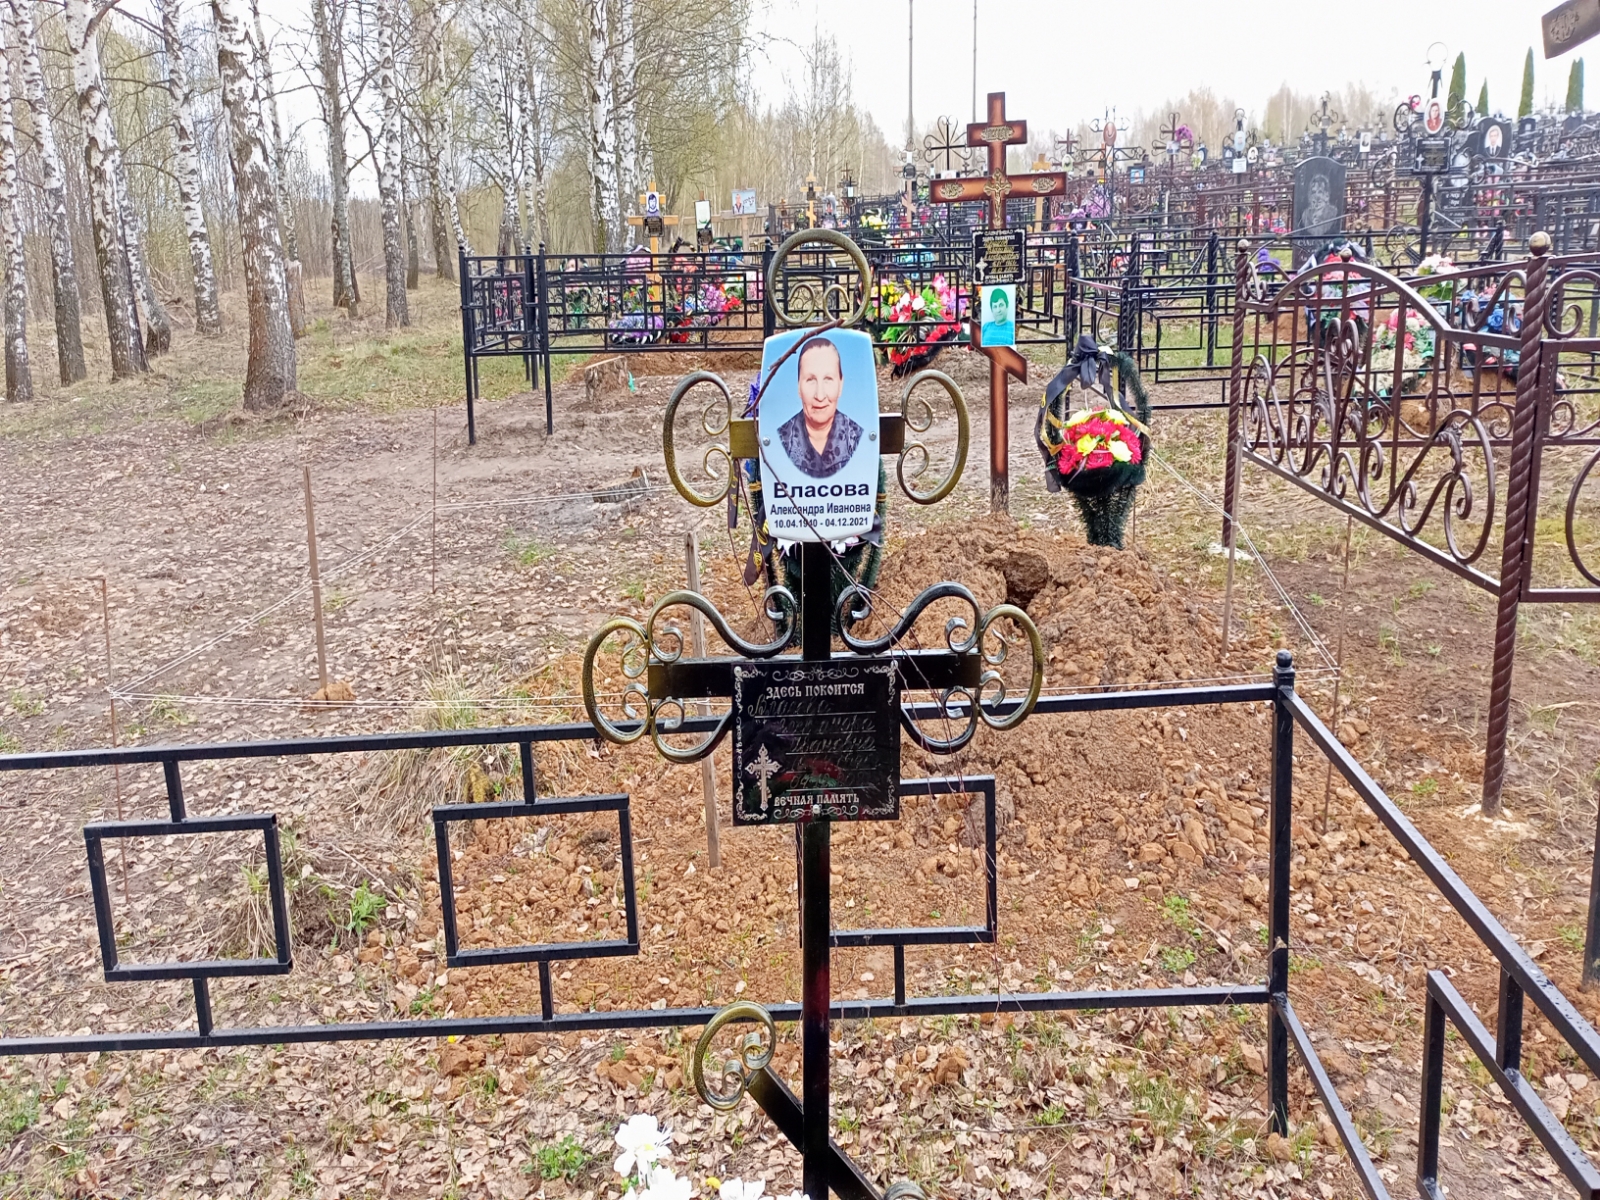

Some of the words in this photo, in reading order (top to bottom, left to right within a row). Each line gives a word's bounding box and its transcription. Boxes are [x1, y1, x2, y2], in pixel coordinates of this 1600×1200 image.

[774, 482, 869, 498] Власова
[770, 504, 824, 516] Александра
[827, 502, 871, 514] Ивановна
[825, 516, 868, 528] 04.12.2021
[766, 685, 801, 701] ЗДЕСЬ
[805, 683, 865, 697] ПОКОИТСЯ
[773, 795, 813, 807] ВЕЧНАЯ
[817, 793, 860, 804] ПАМЯТЬ
